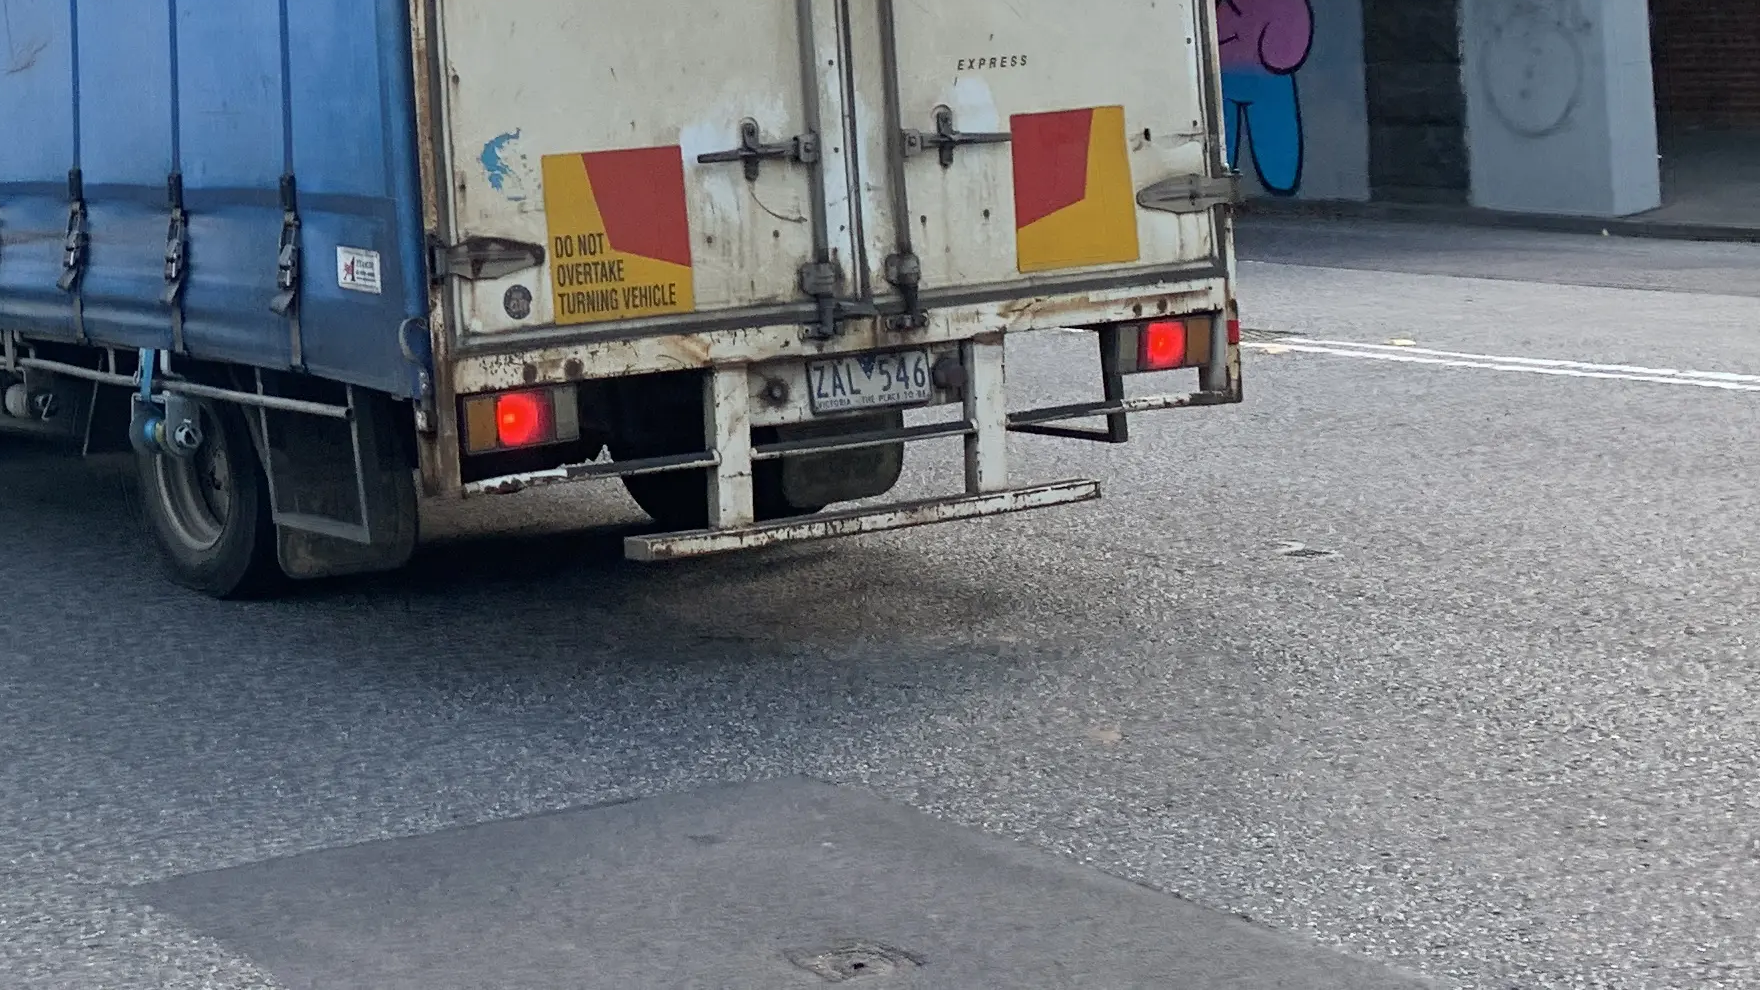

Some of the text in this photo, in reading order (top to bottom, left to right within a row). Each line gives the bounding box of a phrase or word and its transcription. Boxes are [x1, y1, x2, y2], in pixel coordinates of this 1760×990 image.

[957, 54, 1028, 71] EXPRESS
[554, 232, 605, 258] DO NOT
[556, 259, 625, 288] OVERTAKE
[557, 288, 619, 316] TURNING
[621, 282, 677, 310] VEHICLE
[813, 356, 926, 399] ZAL 546
[818, 398, 852, 409] VICTORIA
[862, 394, 875, 404] THE
[904, 390, 914, 399] TO
